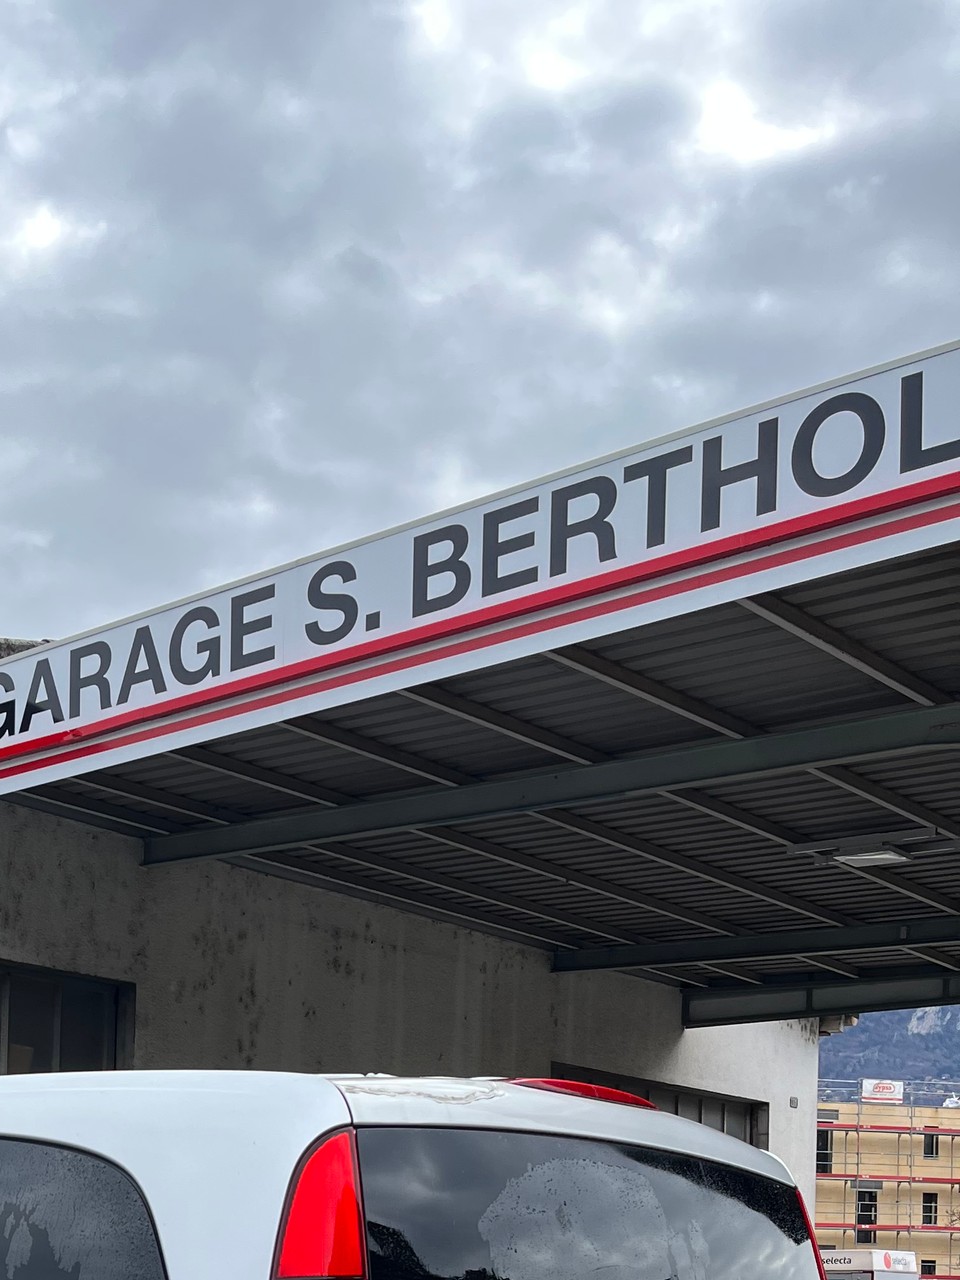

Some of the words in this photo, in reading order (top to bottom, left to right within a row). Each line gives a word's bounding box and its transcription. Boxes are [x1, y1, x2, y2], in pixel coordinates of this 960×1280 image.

[304, 559, 381, 646] S.
[412, 370, 960, 618] BERTHOL
[822, 1257, 852, 1265] selecta
